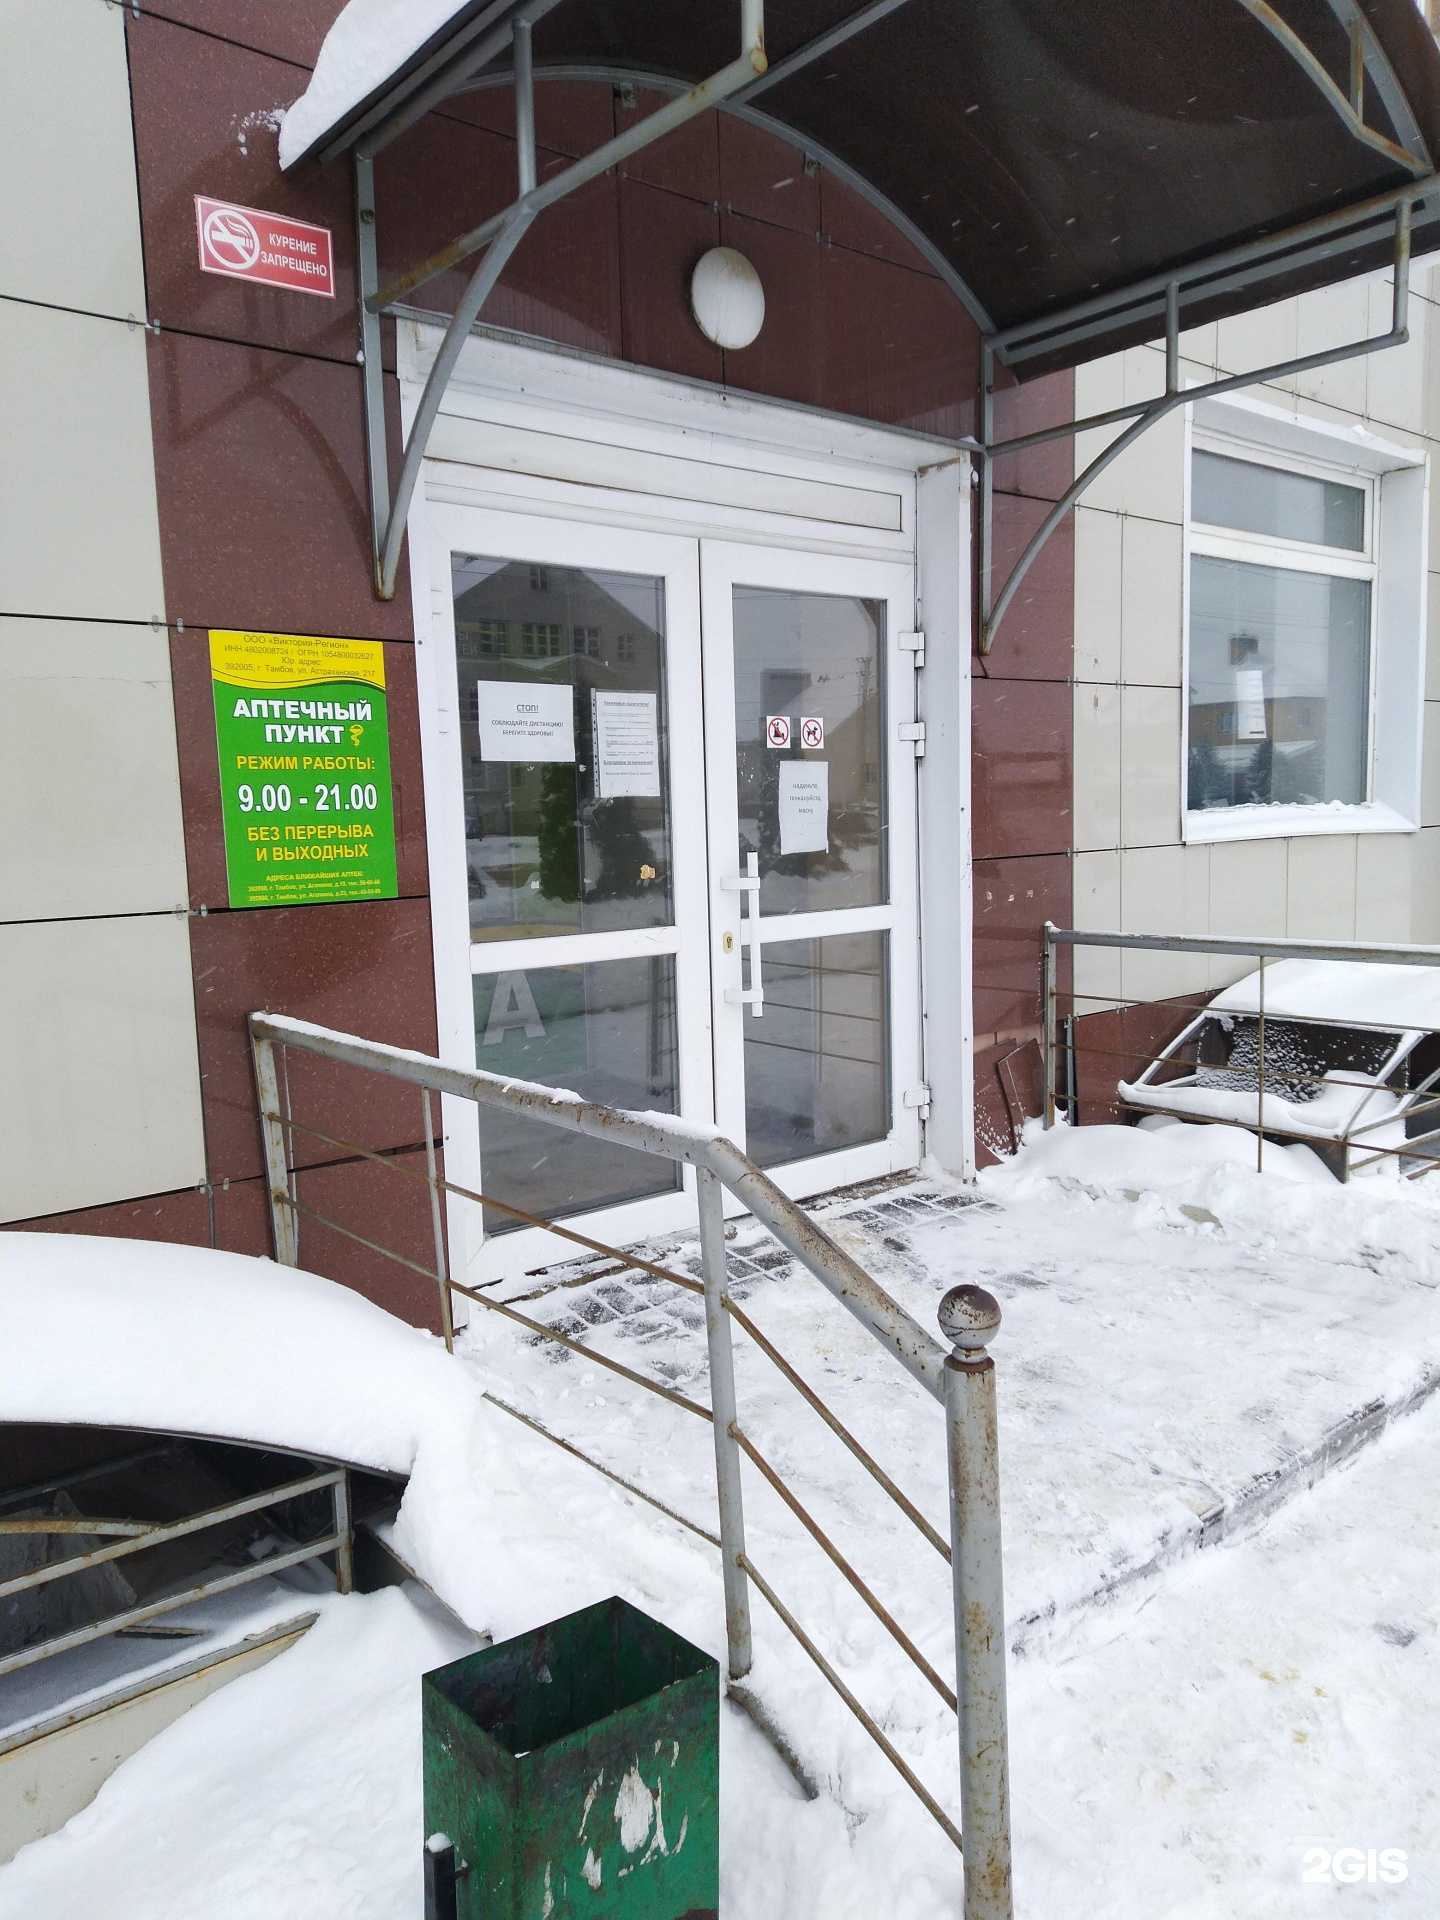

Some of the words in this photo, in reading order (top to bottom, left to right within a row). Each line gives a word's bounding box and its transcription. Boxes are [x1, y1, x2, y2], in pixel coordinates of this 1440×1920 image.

[268, 232, 317, 255] КУРЕНИЕ
[260, 250, 327, 277] ЗАПРЕЩЕНО
[243, 634, 265, 644] ООО
[233, 698, 372, 721] АПТЕЧНЫЙ
[516, 704, 539, 713] СТОП!
[491, 719, 528, 727] СОБЛЮДАЙТЕ
[265, 724, 344, 744] ПУНКТ
[236, 755, 298, 770] РЕЖИМ
[303, 756, 376, 770] РАБОТЫ:
[238, 784, 292, 812] 9.00
[314, 783, 378, 811] 21.00
[247, 826, 280, 841] БЕЗ
[285, 824, 374, 840] ПЕРЕРЫВА
[256, 847, 267, 862] И
[272, 844, 369, 861] ВЫХОДНЫХ
